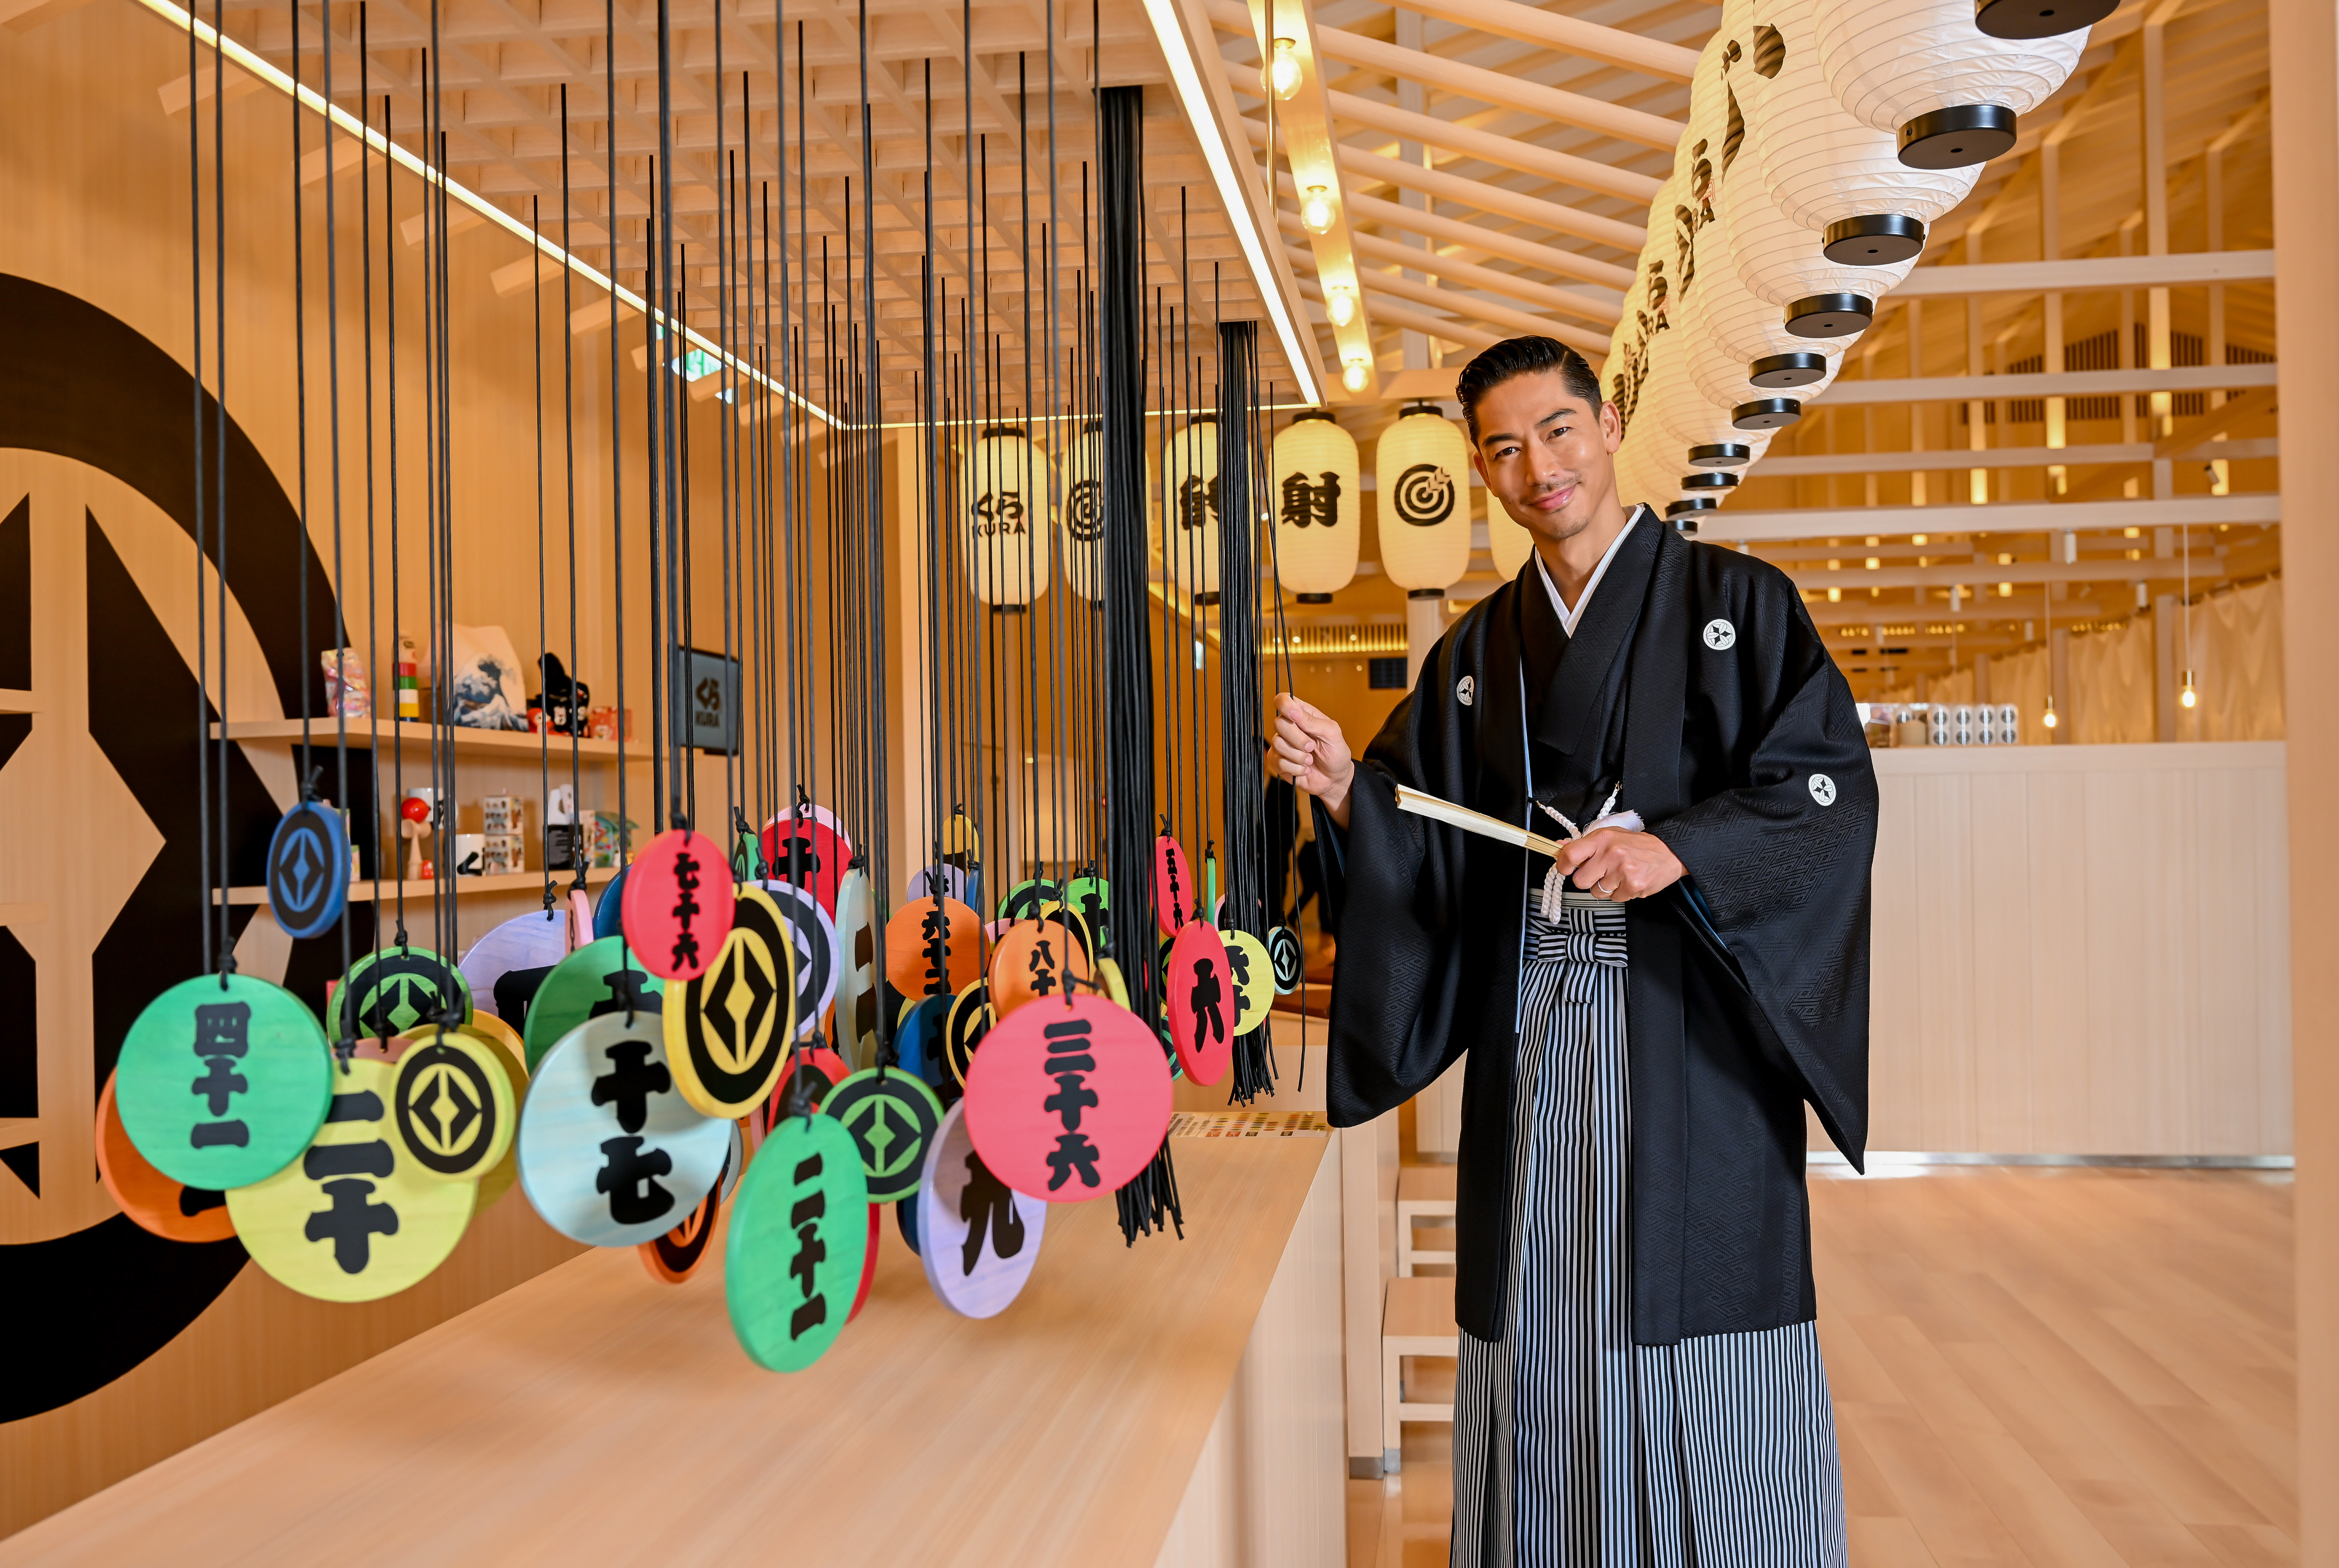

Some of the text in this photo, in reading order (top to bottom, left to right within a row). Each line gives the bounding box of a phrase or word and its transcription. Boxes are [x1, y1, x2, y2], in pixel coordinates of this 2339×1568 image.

[972, 521, 1026, 538] KURA
[1281, 471, 1341, 528] 射
[672, 852, 700, 972] 七十六
[190, 1001, 251, 1149] 四十一
[591, 1040, 675, 1225] 十七
[1044, 1019, 1099, 1192] 三十六
[303, 1090, 399, 1274] 二十
[790, 1152, 826, 1341] 二十一
